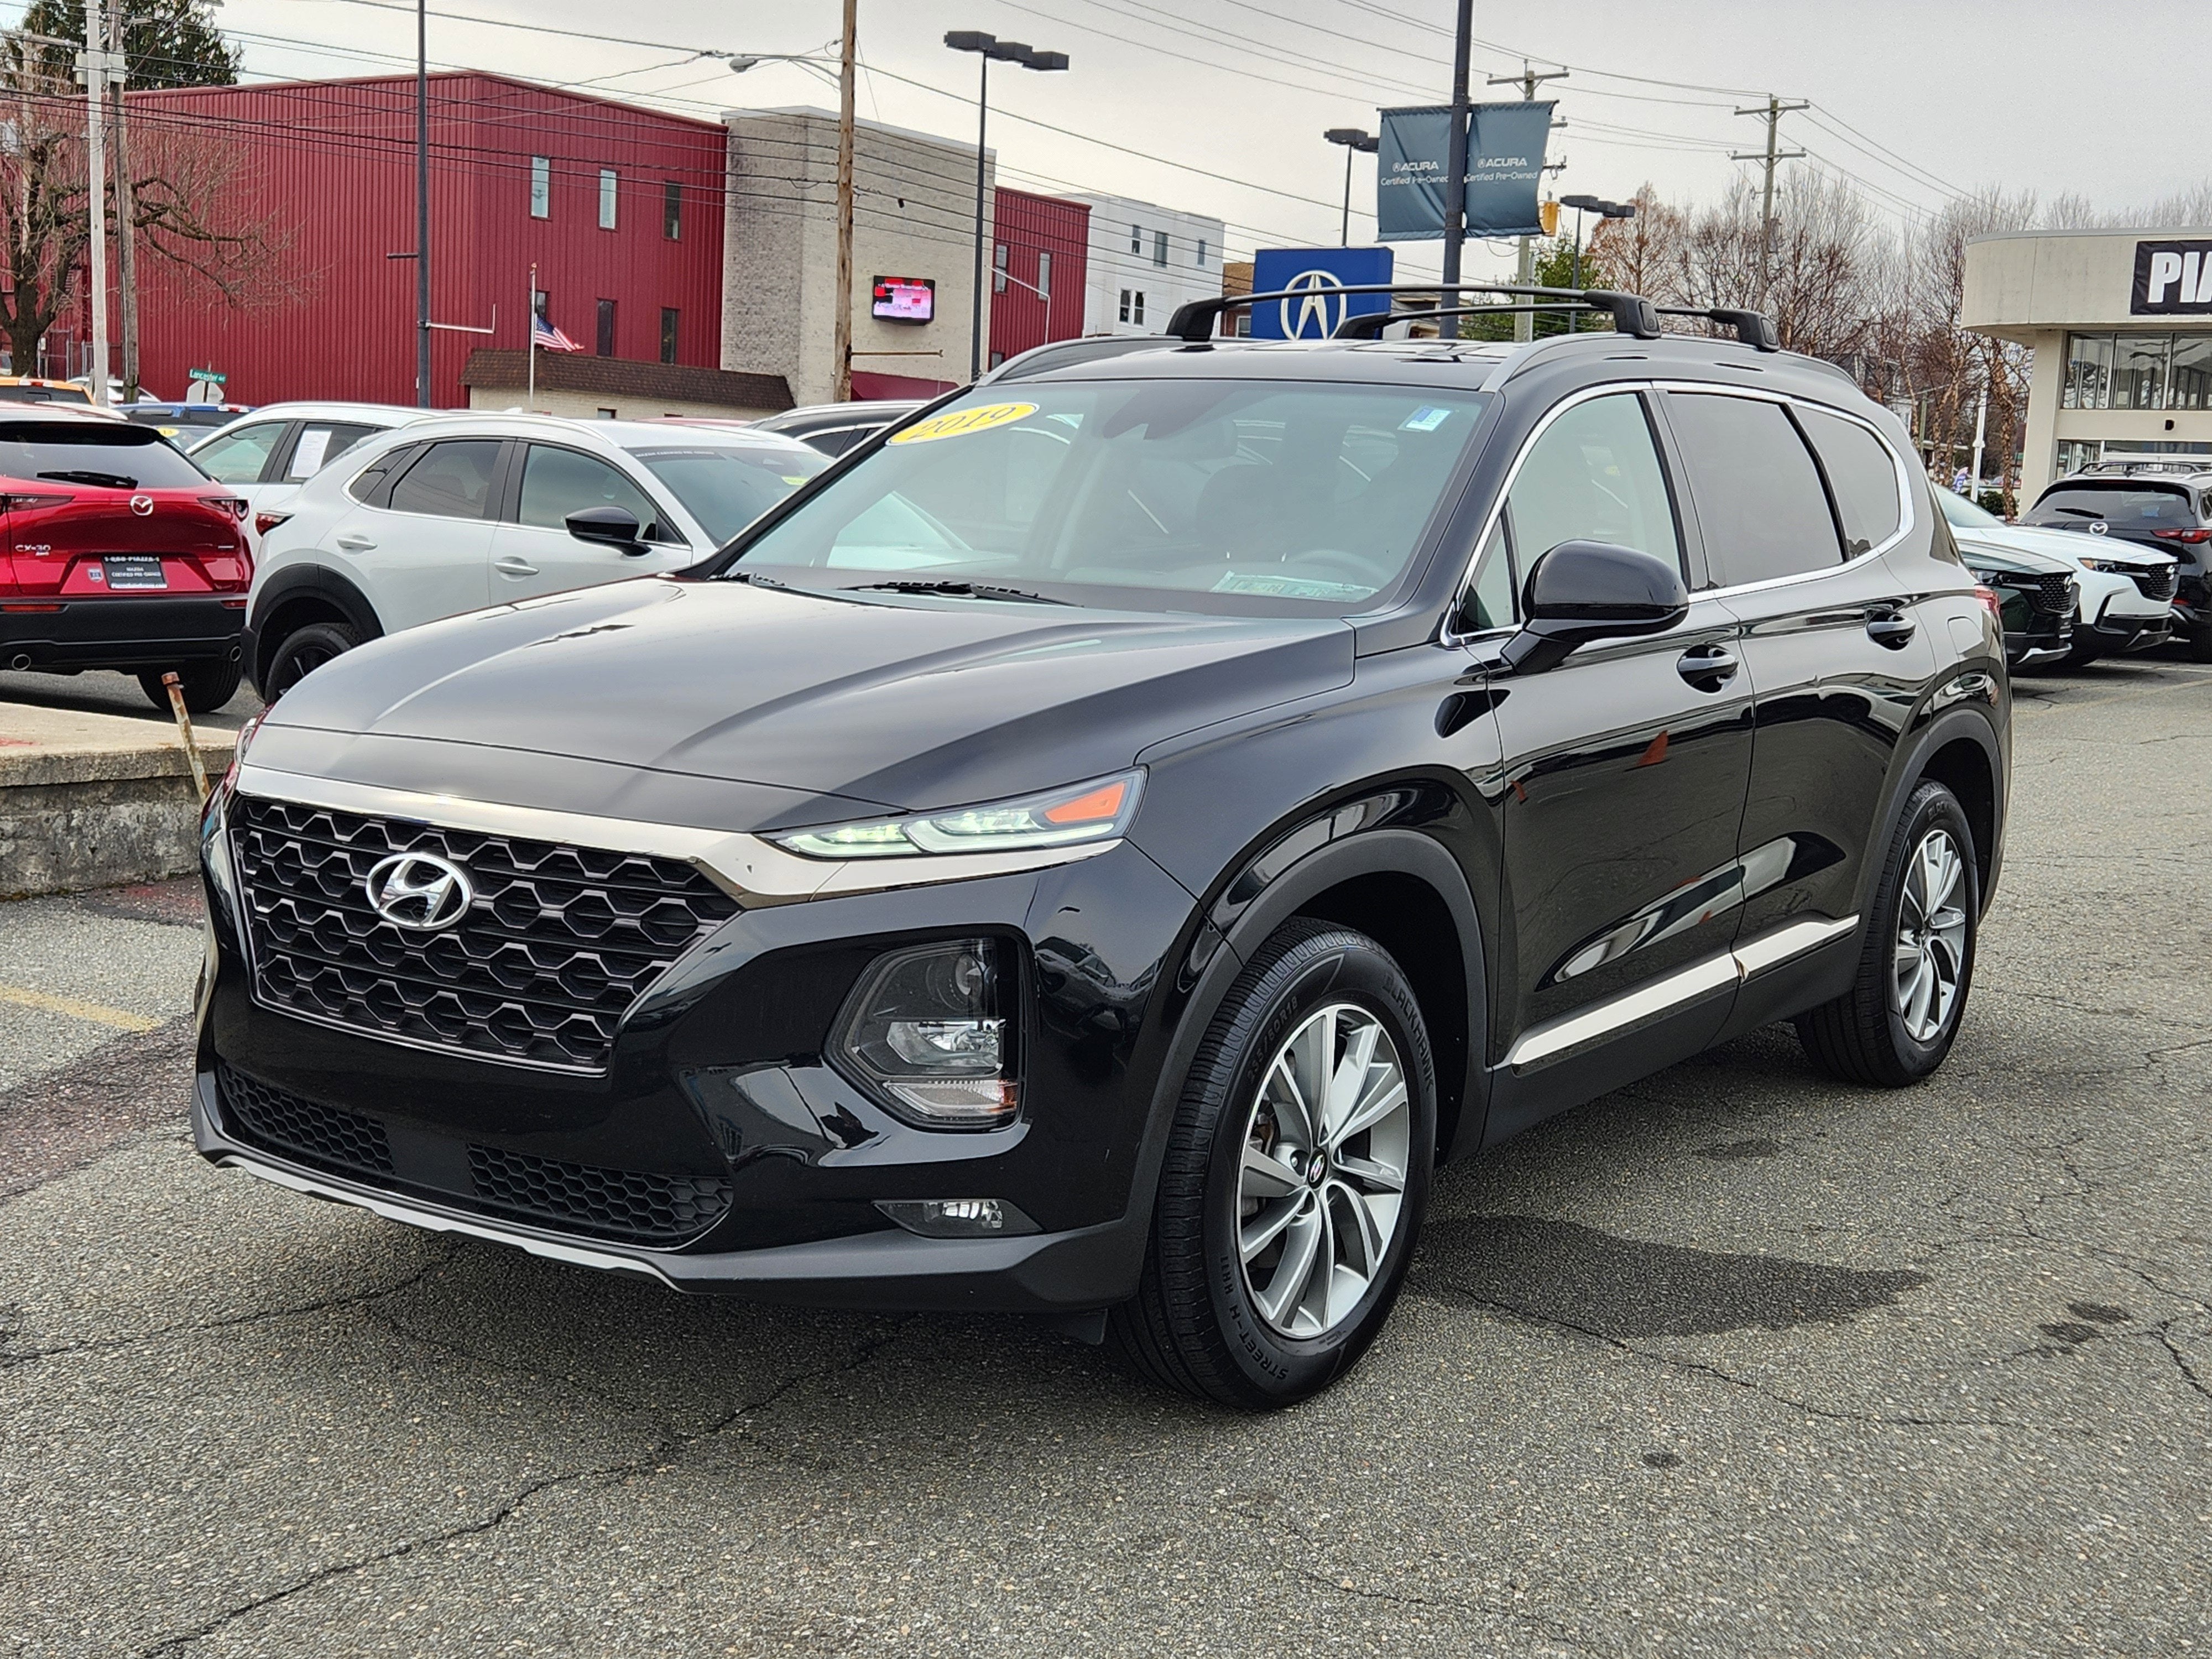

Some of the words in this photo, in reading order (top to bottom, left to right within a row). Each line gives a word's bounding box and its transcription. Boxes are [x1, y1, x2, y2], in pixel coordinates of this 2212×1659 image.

[1400, 161, 1439, 171] ACURA
[1485, 157, 1527, 168] ACURA
[1381, 177, 1411, 186] Certified
[1466, 173, 1494, 182] Certified
[1495, 171, 1538, 180] Pre-Owned
[907, 406, 1017, 440] 2019
[1381, 971, 1434, 1093] BLACKHAWK
[1229, 1305, 1289, 1380] STREET-H
